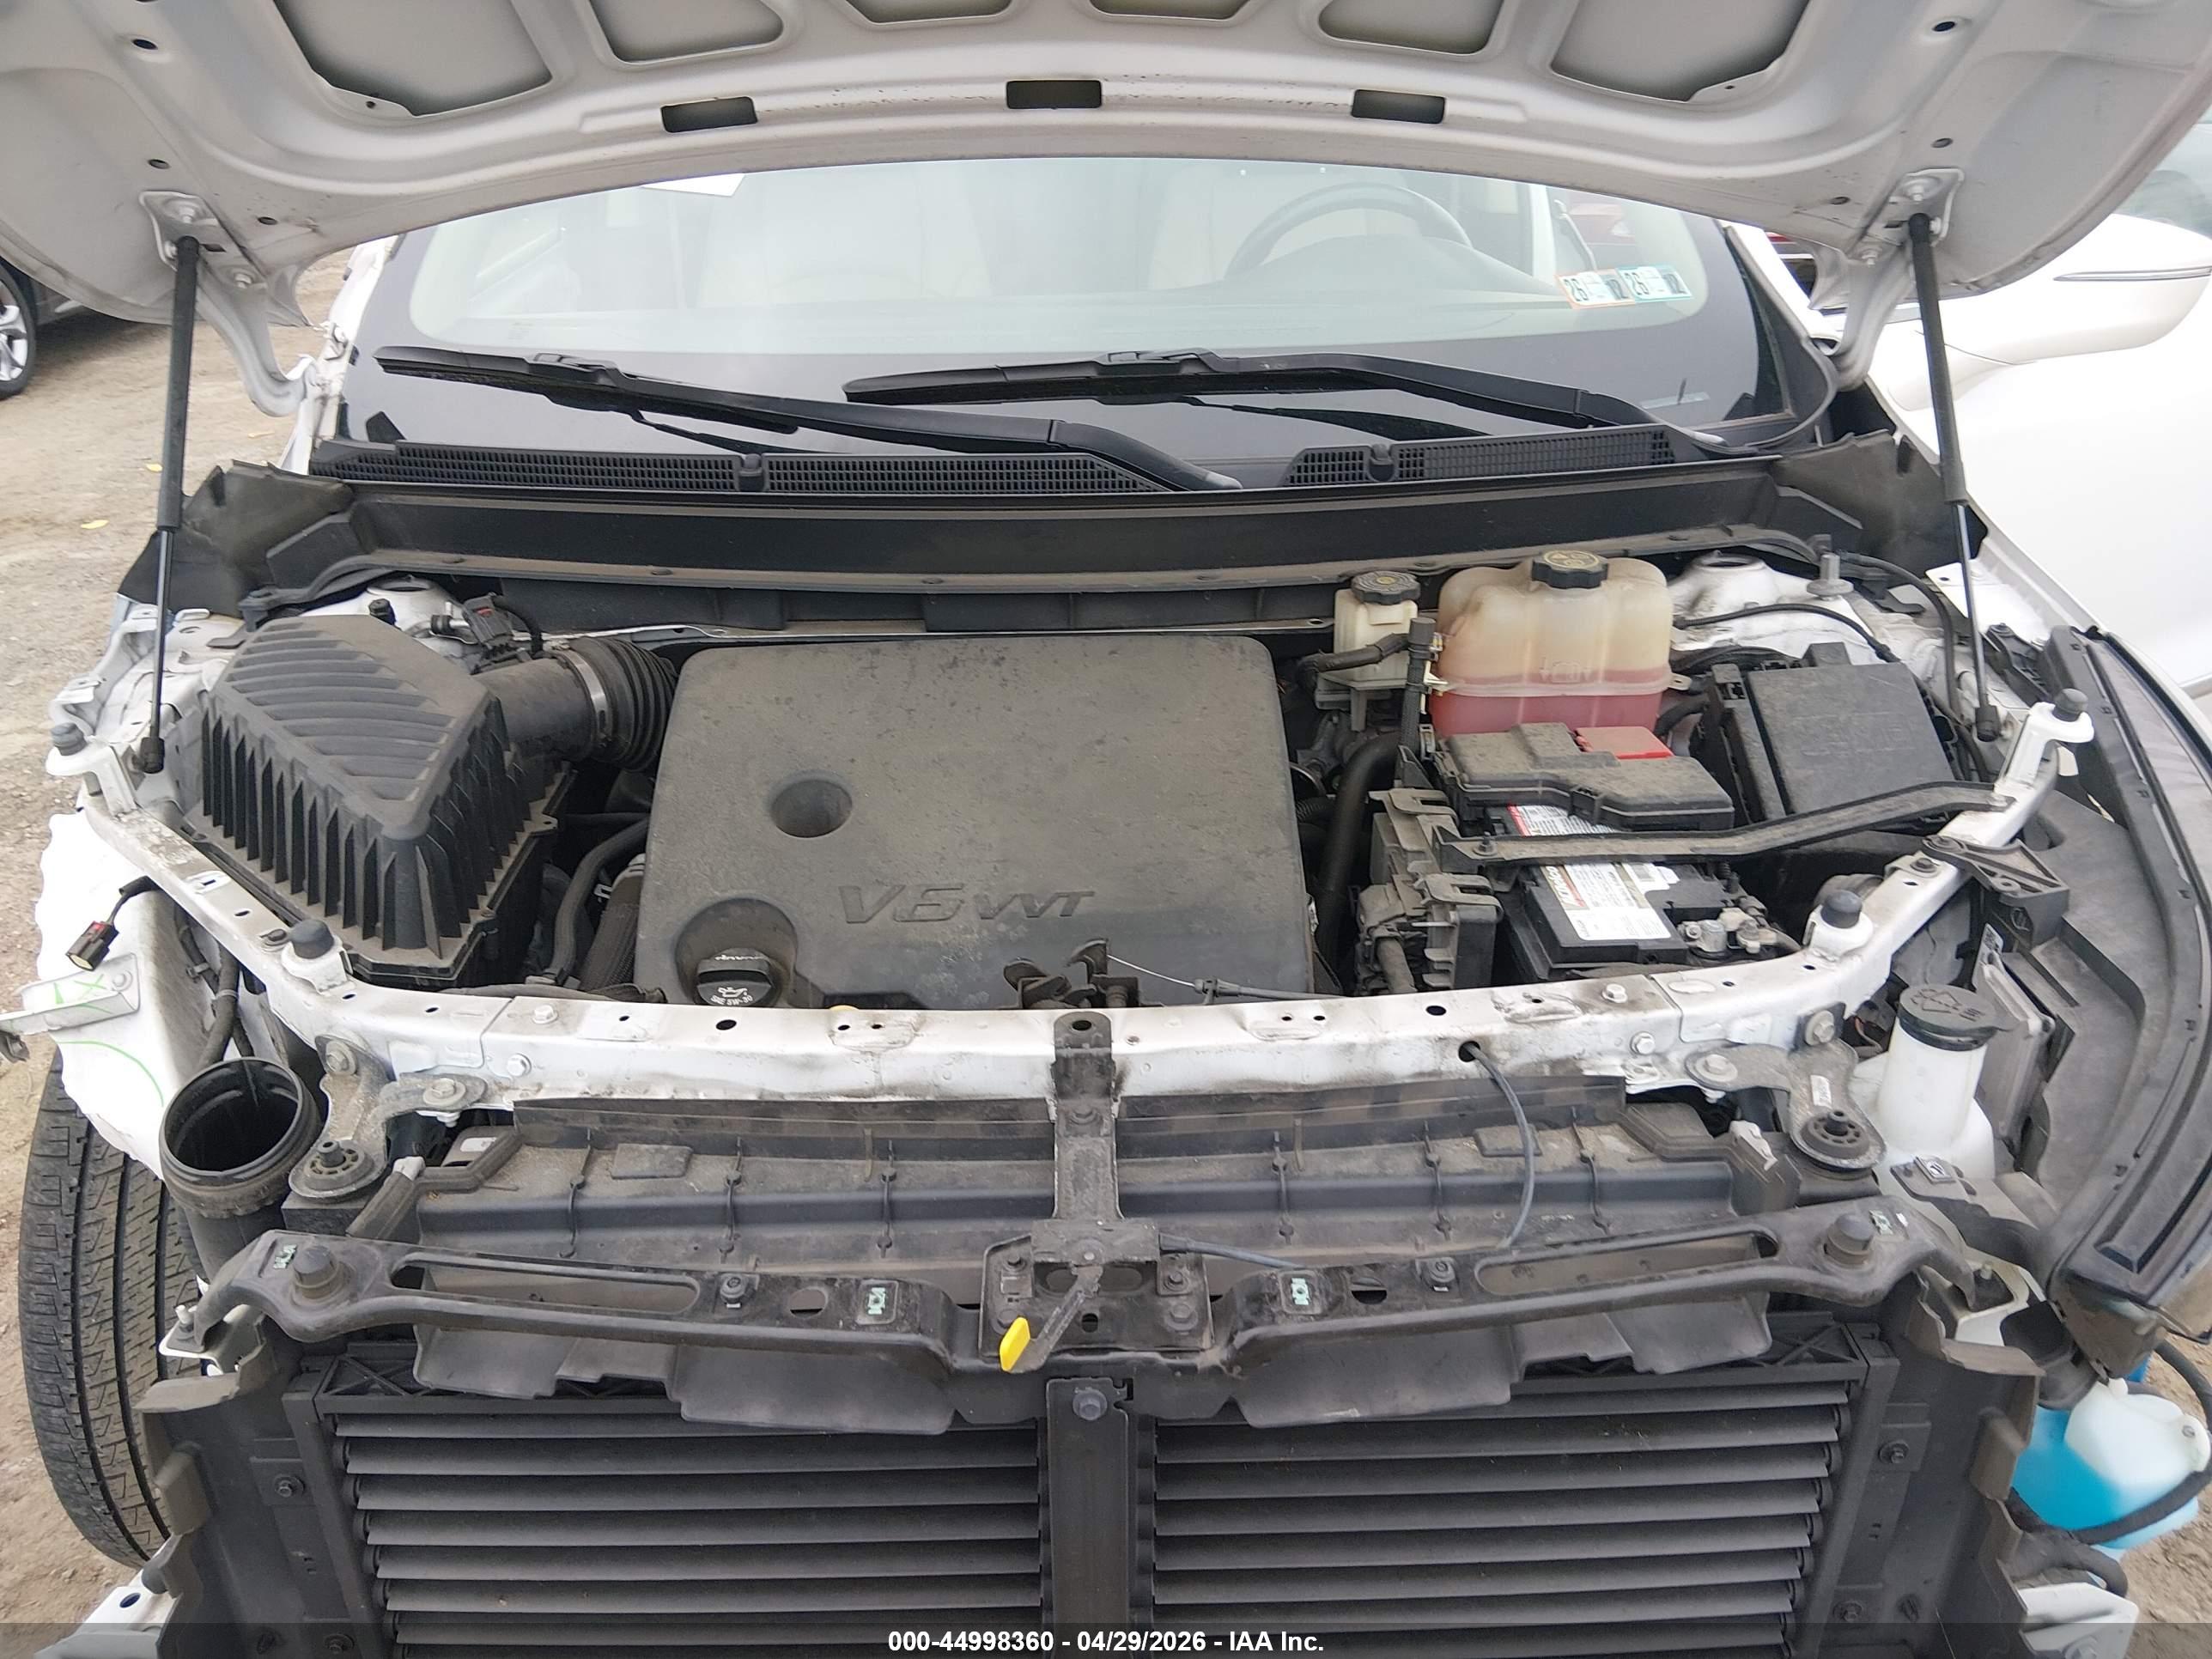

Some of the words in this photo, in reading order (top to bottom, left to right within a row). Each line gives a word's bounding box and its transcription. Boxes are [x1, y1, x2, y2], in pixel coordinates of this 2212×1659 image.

[838, 883, 965, 924] V6
[973, 890, 1096, 920] VVT
[710, 994, 726, 1006] SAE
